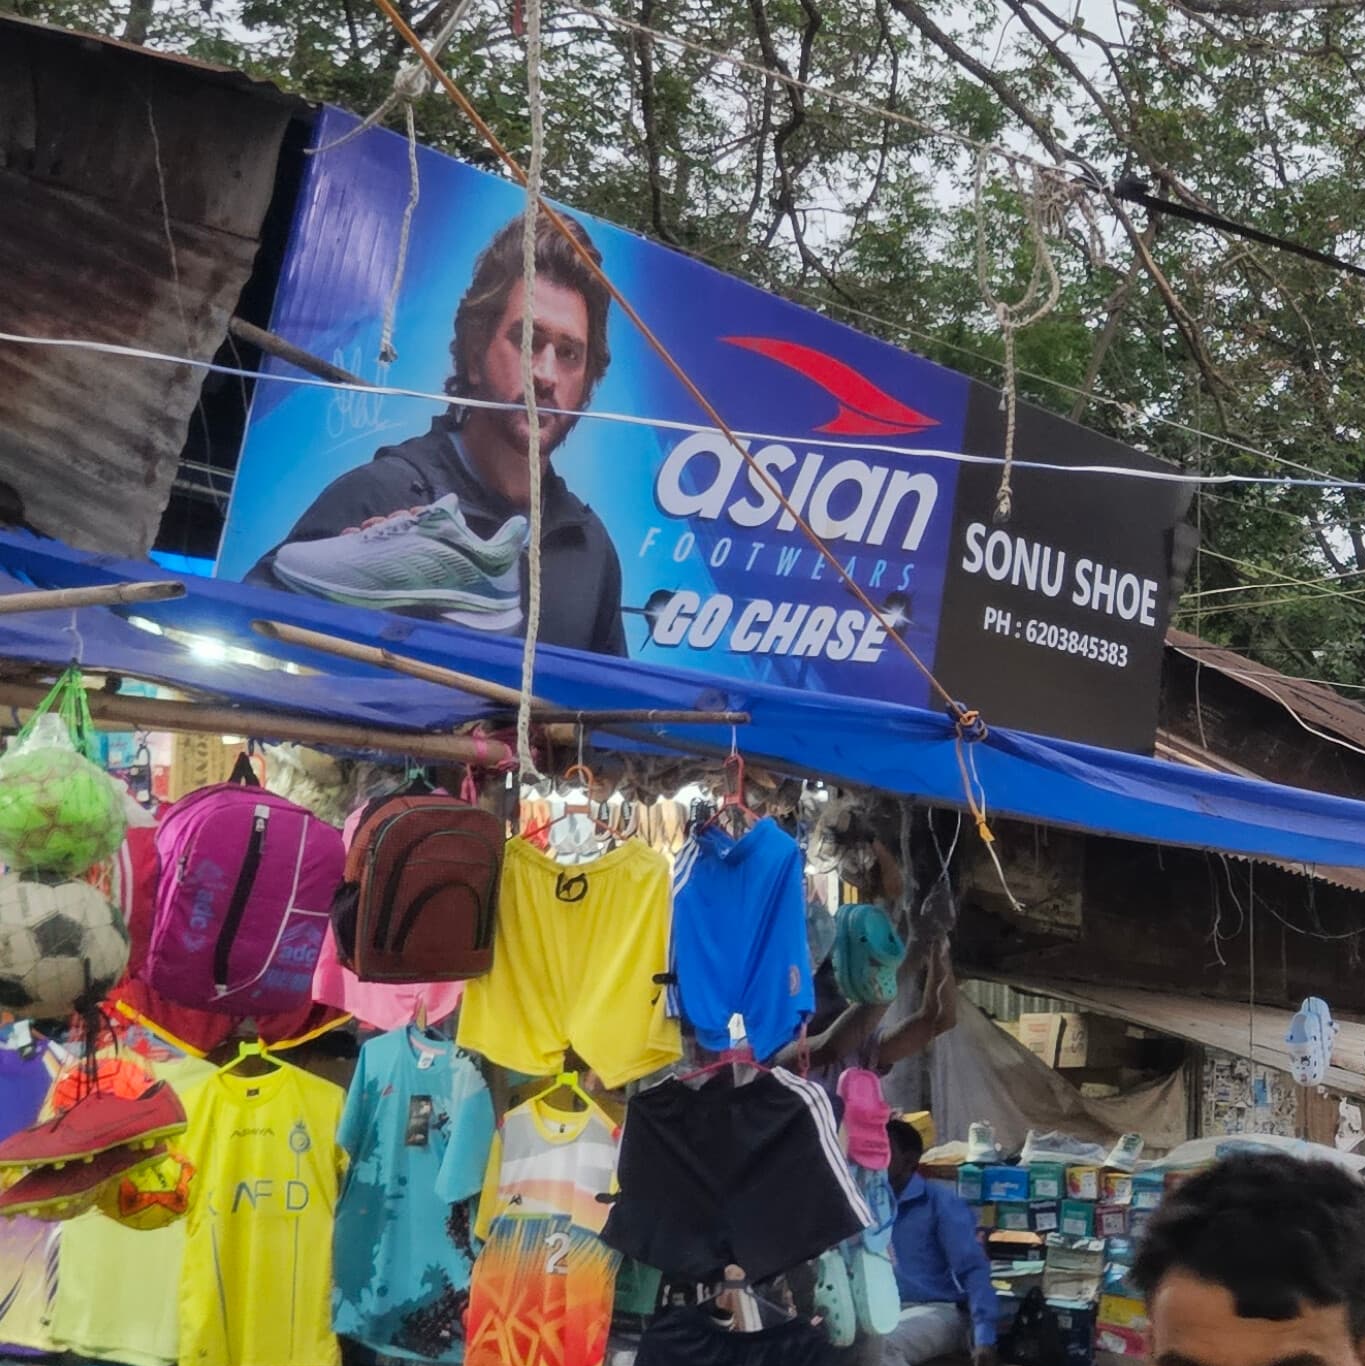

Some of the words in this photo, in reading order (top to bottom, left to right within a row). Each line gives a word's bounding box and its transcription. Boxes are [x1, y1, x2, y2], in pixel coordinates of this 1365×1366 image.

[656, 431, 938, 551] asian
[639, 527, 915, 592] FOOTWEARS
[962, 522, 1066, 597] SONU
[1072, 558, 1158, 627] SHOE
[652, 589, 734, 652] GO
[729, 598, 897, 663] CHASE
[983, 606, 1012, 636] PH
[1025, 619, 1129, 668] 6203845383
